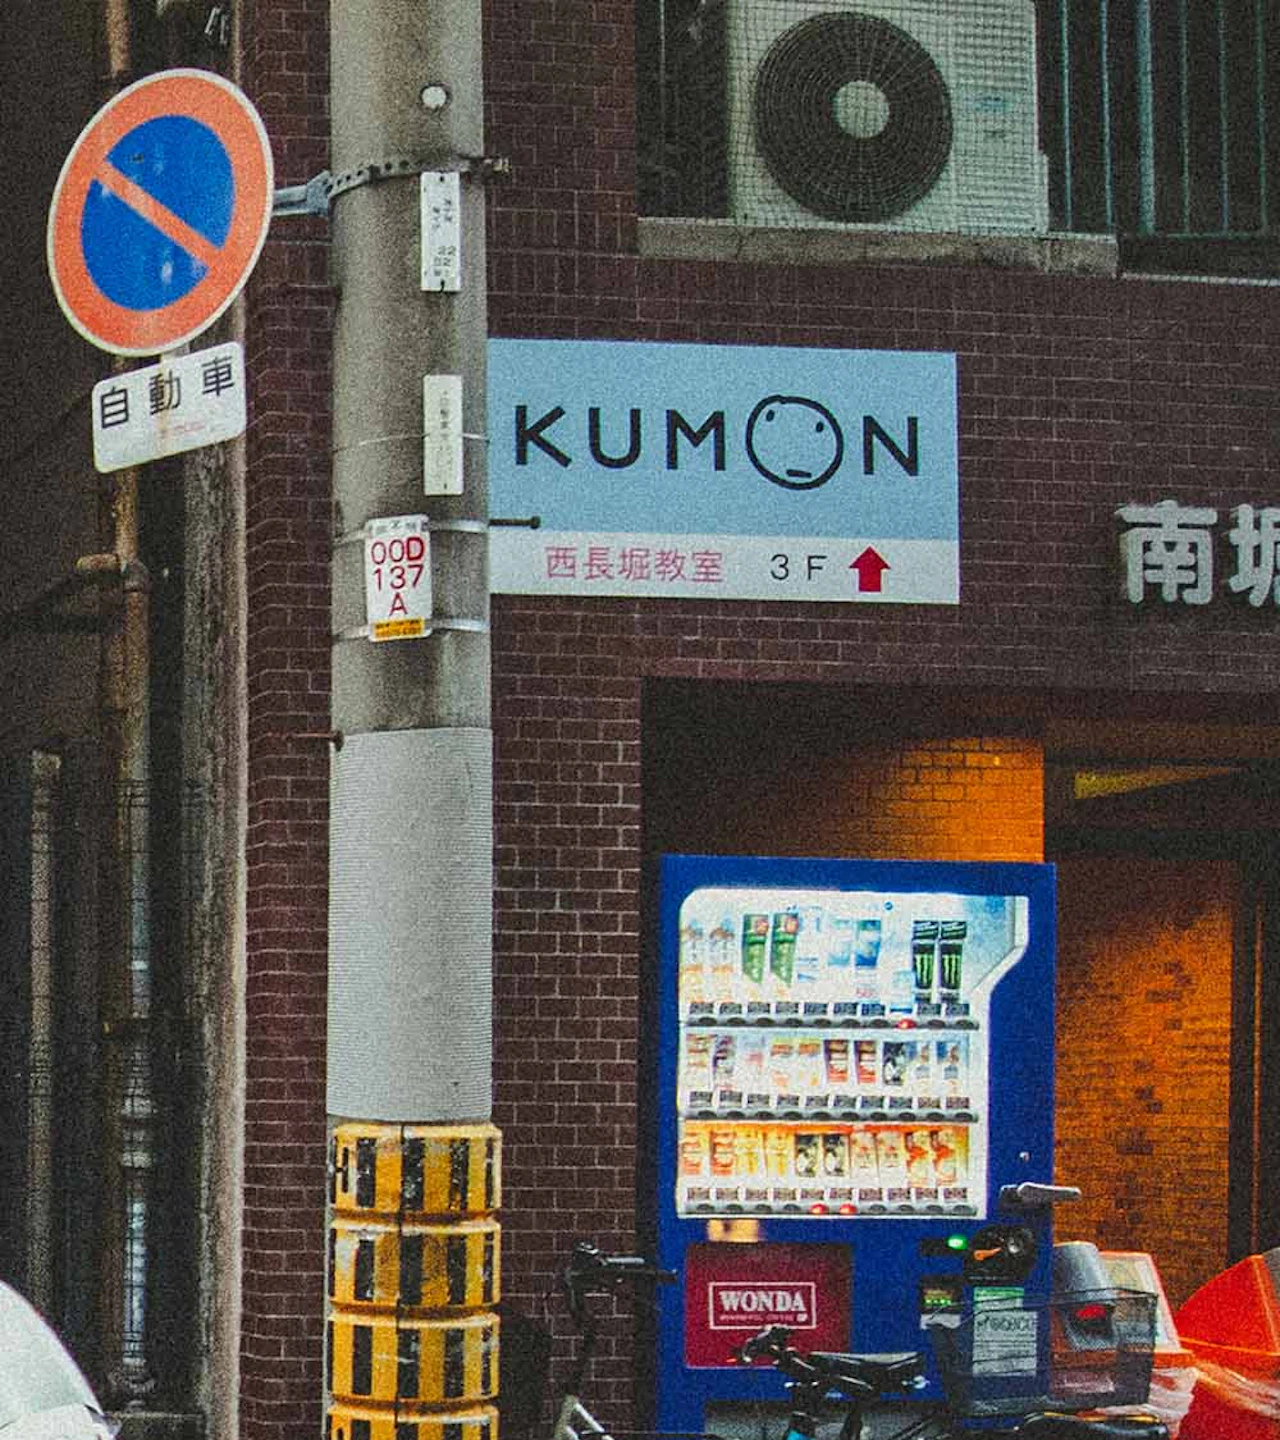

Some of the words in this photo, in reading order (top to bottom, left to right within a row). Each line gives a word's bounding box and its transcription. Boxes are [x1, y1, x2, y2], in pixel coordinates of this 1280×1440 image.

[100, 356, 236, 430] 自動車
[515, 394, 921, 491] KUMON
[373, 564, 424, 592] 137
[544, 545, 725, 584] 西長堀教室
[389, 592, 408, 617] A
[719, 1290, 807, 1312] WONDA
